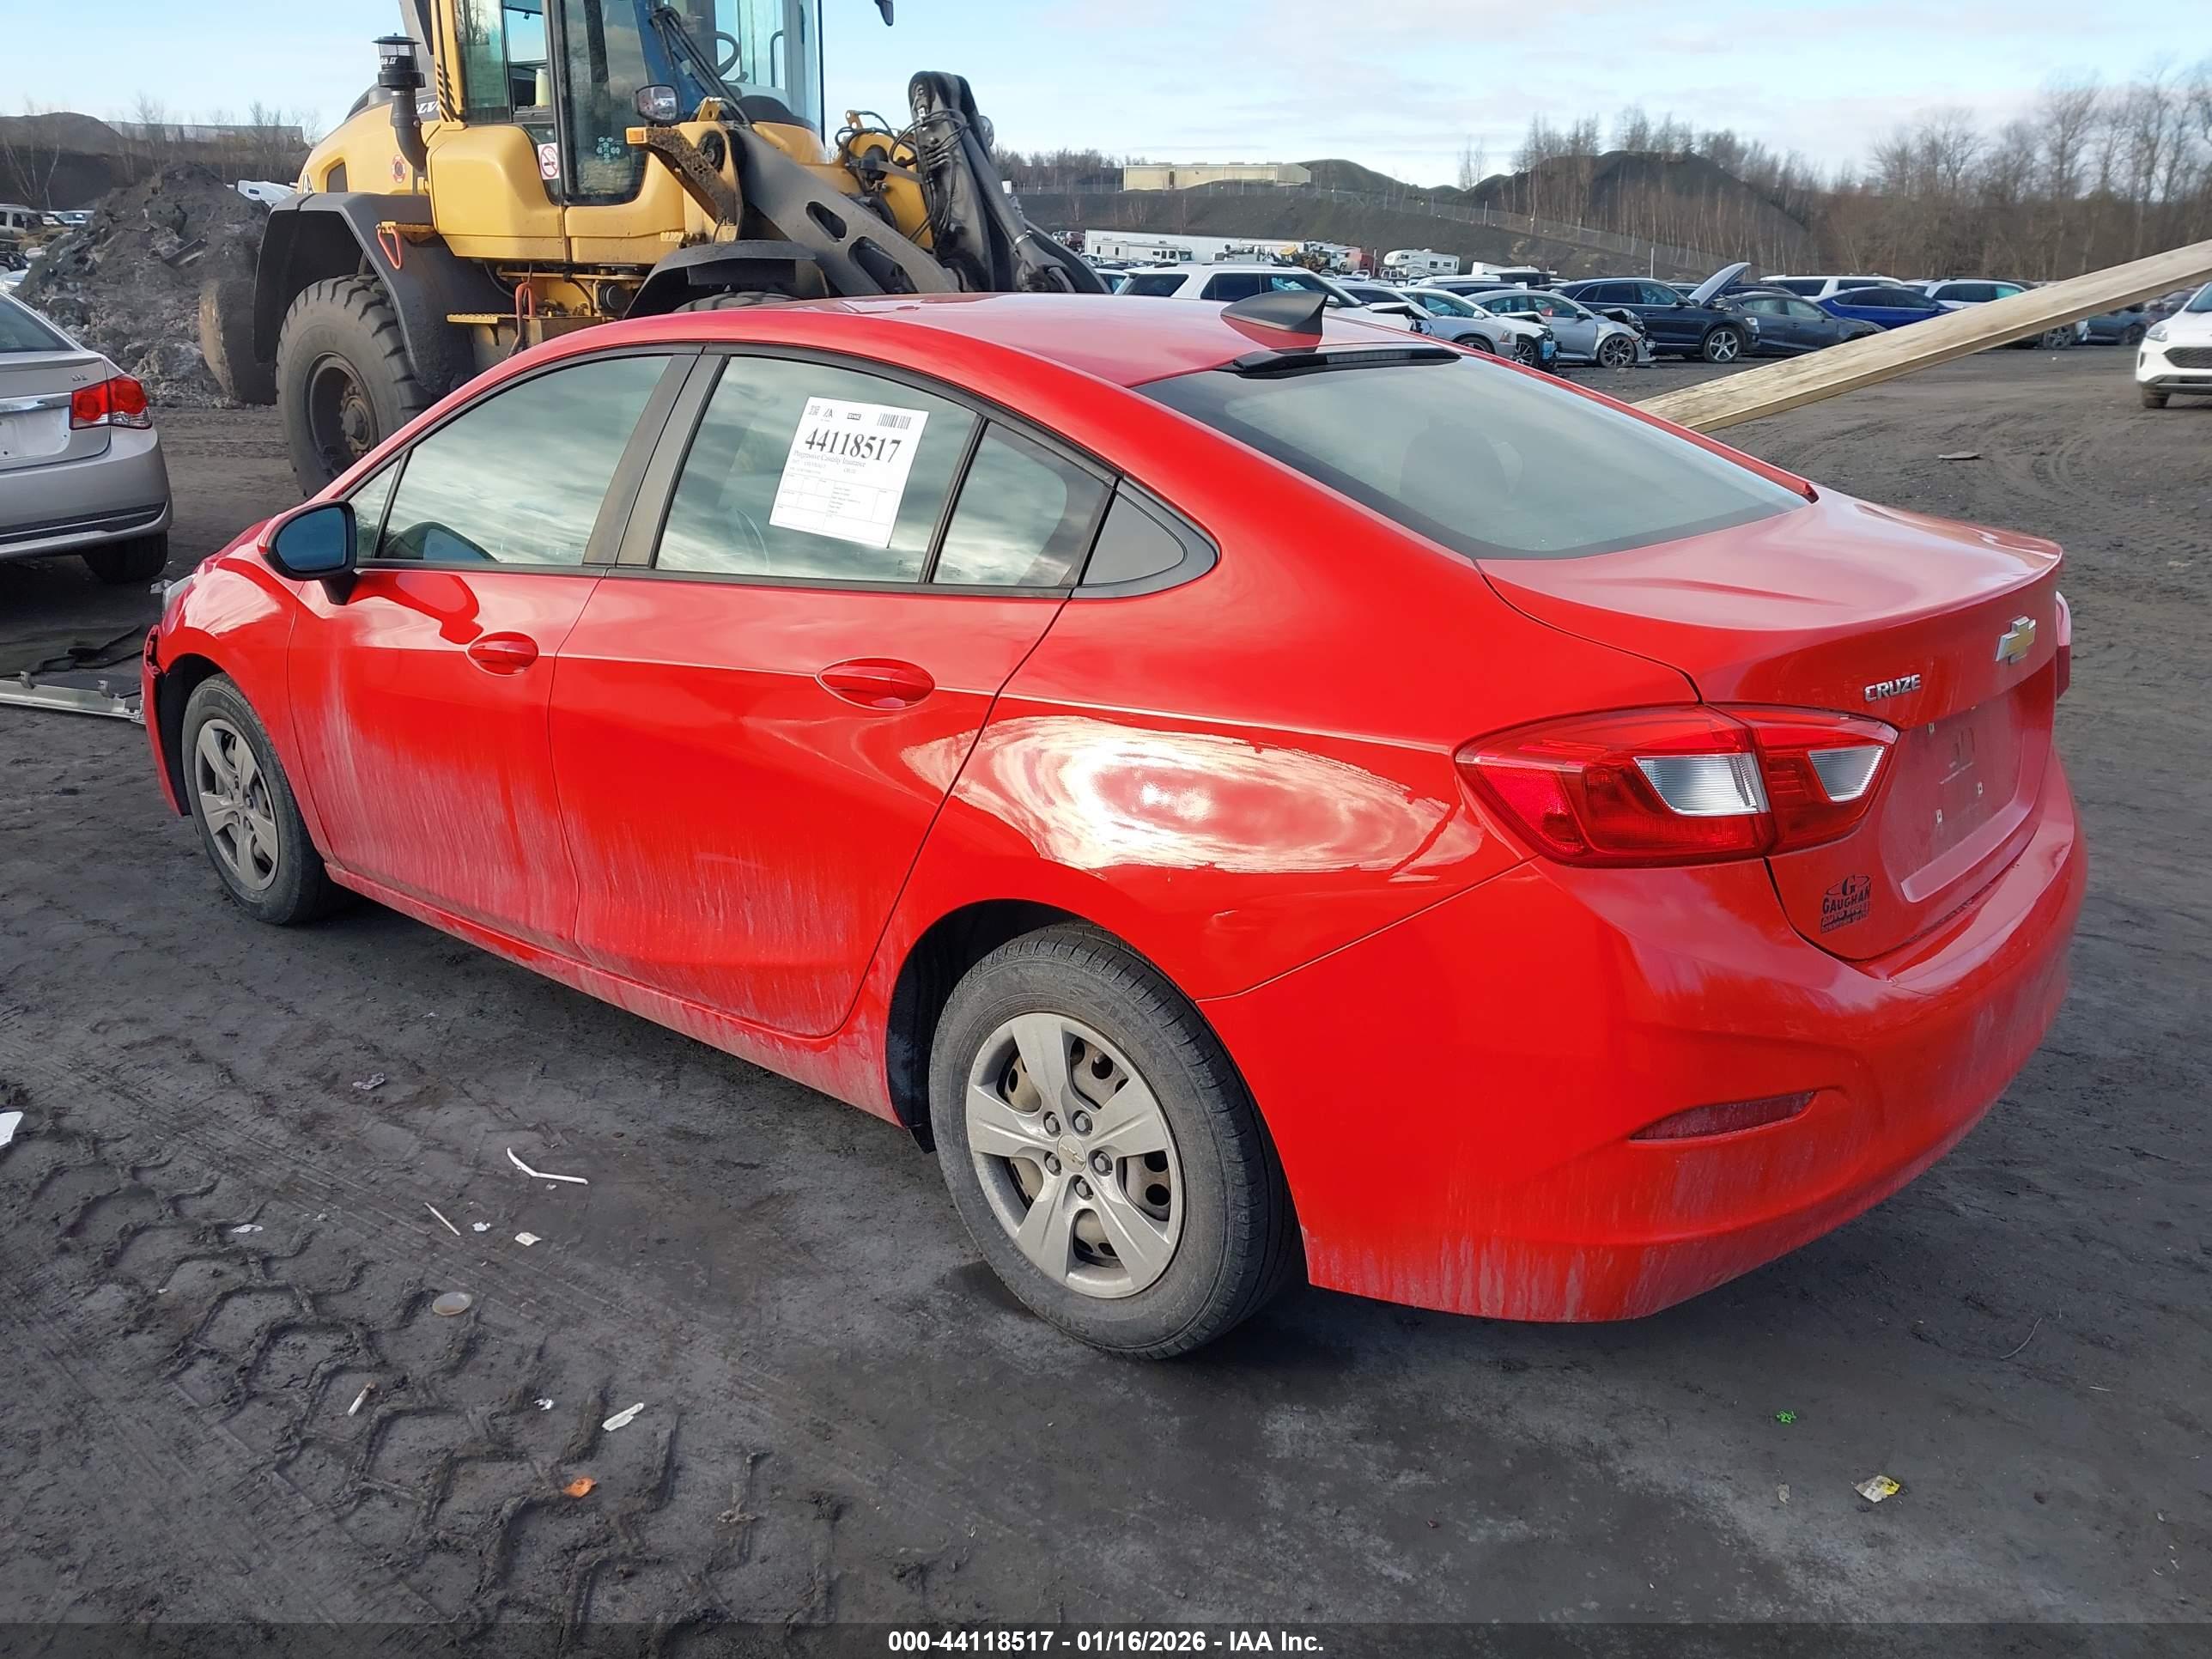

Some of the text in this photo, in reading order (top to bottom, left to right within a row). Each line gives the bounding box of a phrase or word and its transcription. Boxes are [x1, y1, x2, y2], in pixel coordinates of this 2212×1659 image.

[805, 428, 902, 464] 44118517
[1863, 673, 1922, 702] CRUZE
[1822, 882, 1872, 915] GAUGHAN
